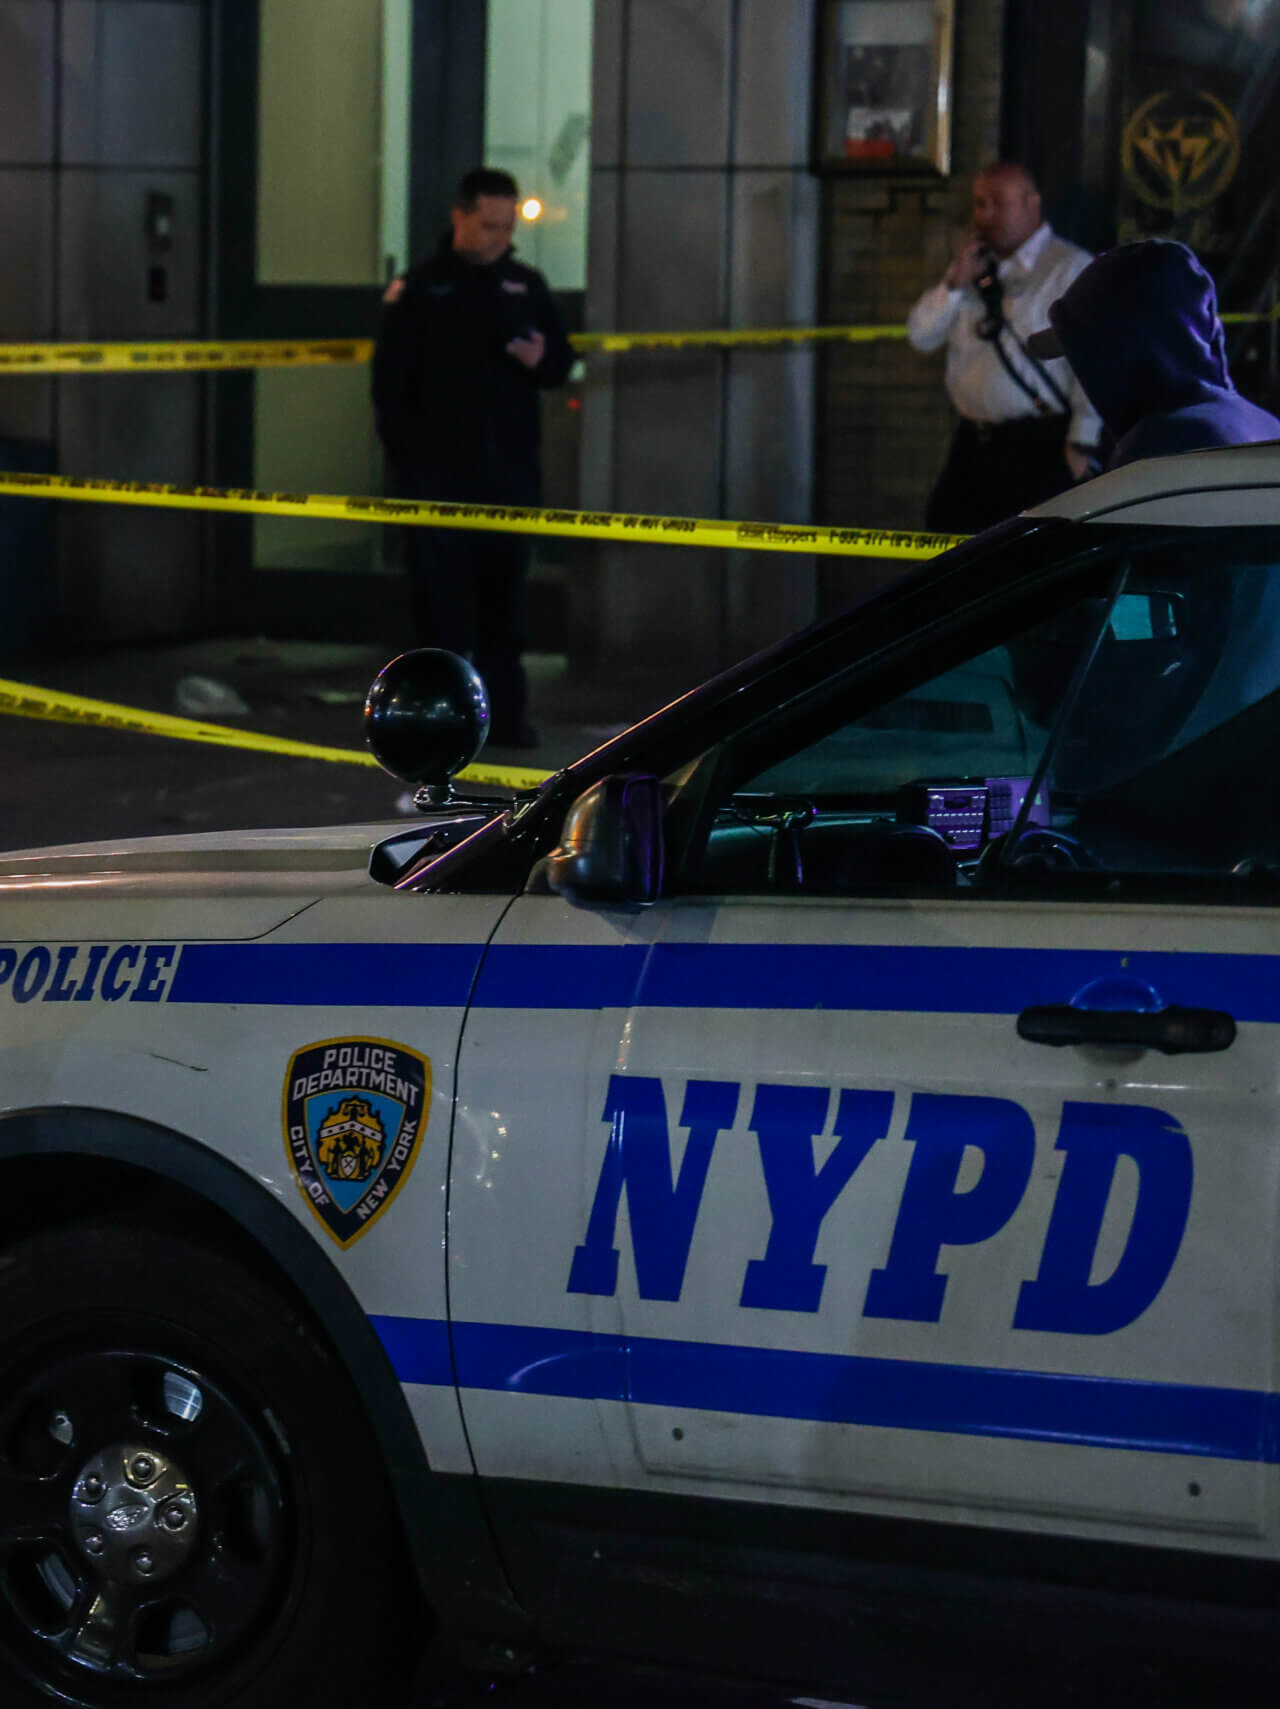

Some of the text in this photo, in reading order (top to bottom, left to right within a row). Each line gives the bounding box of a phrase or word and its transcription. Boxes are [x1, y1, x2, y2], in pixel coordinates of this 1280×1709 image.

[292, 1067, 419, 1107] DEPARTMENT
[323, 1046, 397, 1073] POLICE
[290, 1125, 331, 1206] CITY OF
[356, 1119, 418, 1221] NEW YORK
[566, 1074, 1194, 1337] NYPD
